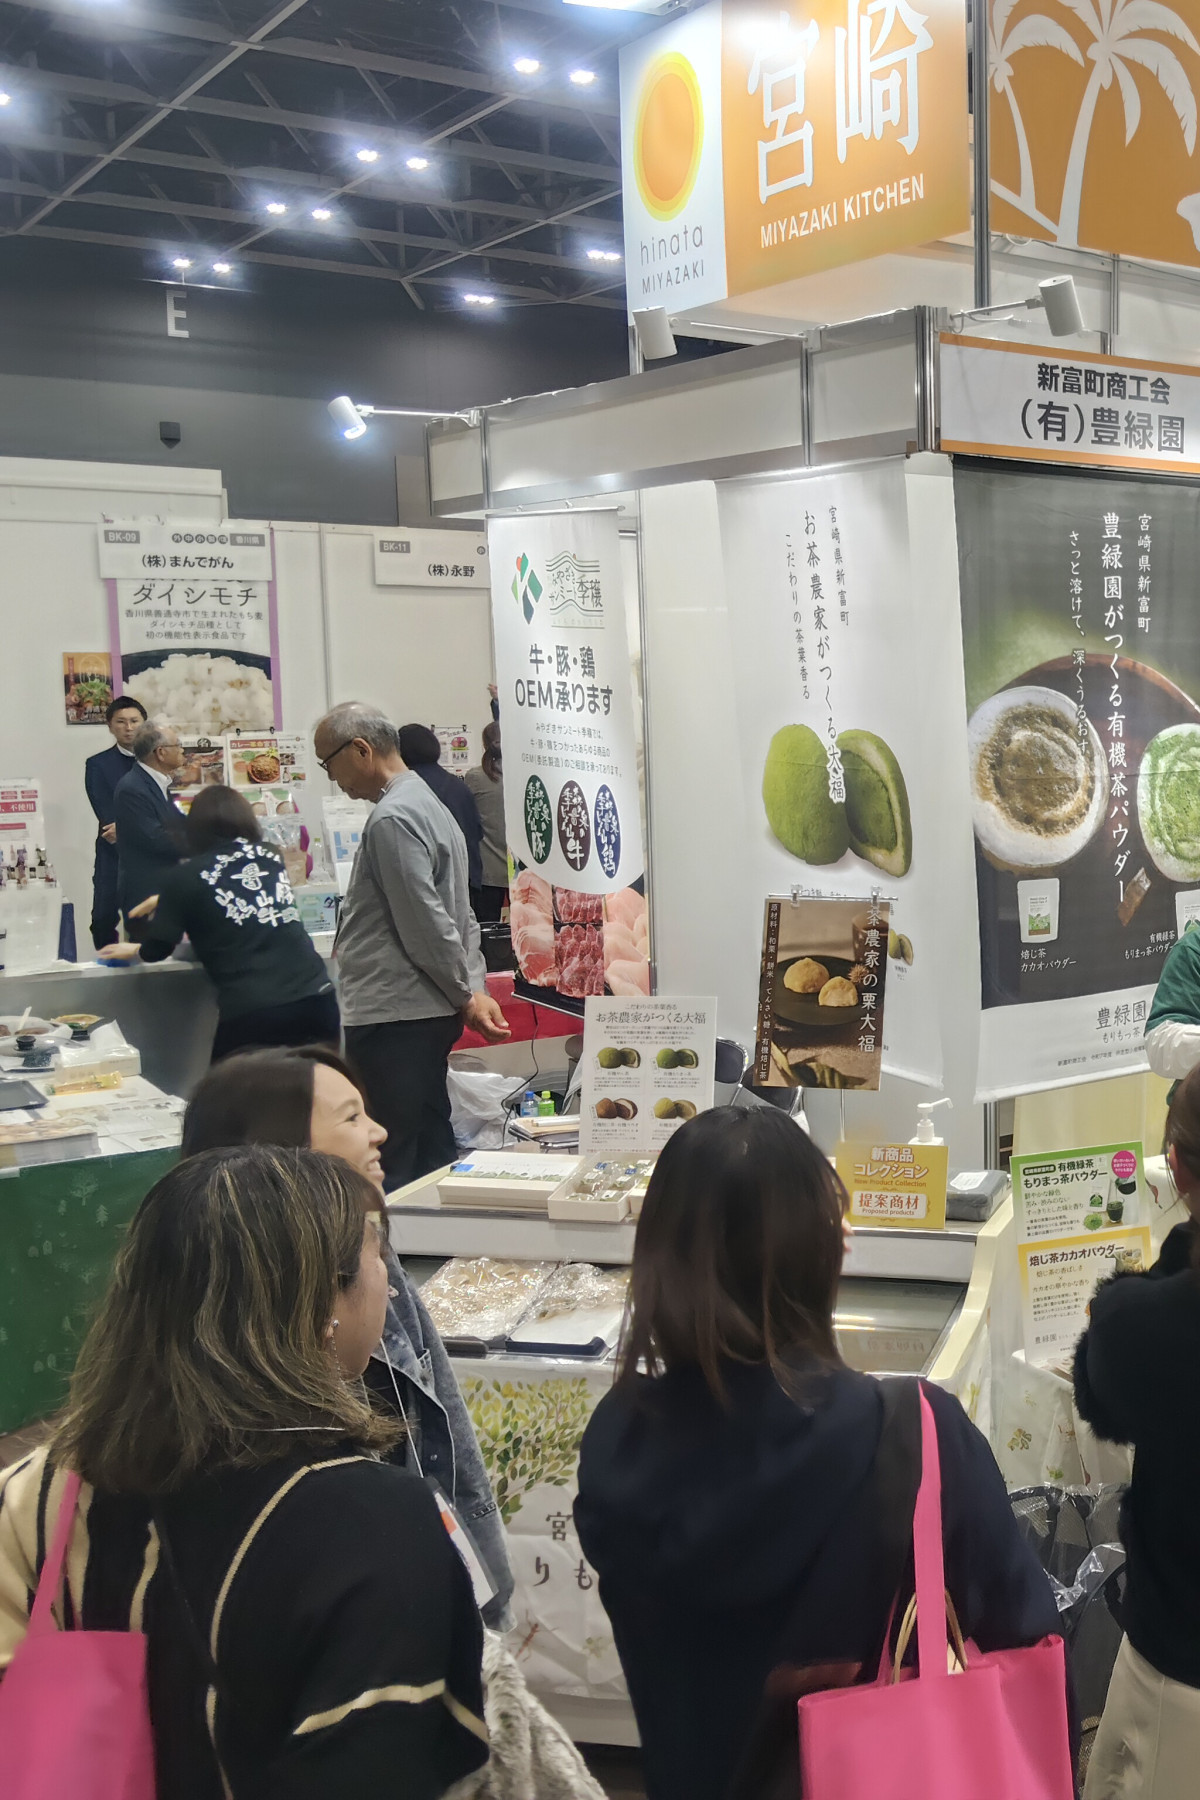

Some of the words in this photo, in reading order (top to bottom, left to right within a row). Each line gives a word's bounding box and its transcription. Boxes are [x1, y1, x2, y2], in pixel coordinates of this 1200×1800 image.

[747, 0, 934, 204] 宮崎
[760, 206, 838, 249] MIYAZAKI
[843, 173, 925, 222] KITCHEN
[640, 223, 704, 267] hinata
[641, 261, 705, 295] MIYAZAKI
[166, 289, 190, 338] E
[1036, 361, 1172, 406] 新富町商工会
[1020, 398, 1186, 455] (有)豊緑園
[108, 531, 137, 542] BK-09
[382, 542, 408, 552] BK-11
[141, 554, 235, 570] (株)まんでがん
[427, 563, 476, 578] (株)永野
[828, 504, 851, 627] 宮崎県新富町
[1136, 512, 1153, 634] 宮崎県新富町
[132, 583, 258, 607] ダイシモチ
[784, 533, 811, 701] こだわりの茶葉香る
[803, 509, 845, 802] お茶農家がつくる大福
[514, 678, 614, 717] OEM承ります
[1100, 511, 1133, 904] 豊緑園がつくる有機茶パウダー
[1149, 930, 1176, 944] 有機緑茶
[1020, 948, 1047, 960] 焙じ茶
[1020, 957, 1077, 973] カカオパウダー
[857, 903, 882, 1054] 茶農家の栗大福
[595, 1011, 707, 1025] お茶農家がつくる大福
[1095, 1000, 1147, 1031] 豊緑園
[871, 1146, 915, 1163] 新商品
[1057, 1158, 1095, 1173] 有機緑茶
[854, 1163, 929, 1180] コレクション
[895, 1179, 927, 1188] Collection
[1023, 1168, 1108, 1189] もりまっ茶パウダー
[858, 1192, 920, 1210] 提案商材
[862, 1207, 888, 1216] Proposed
[889, 1208, 915, 1216] products
[1029, 1243, 1125, 1267] 焙じ茶カカオパウダー
[545, 1511, 573, 1542] 宮
